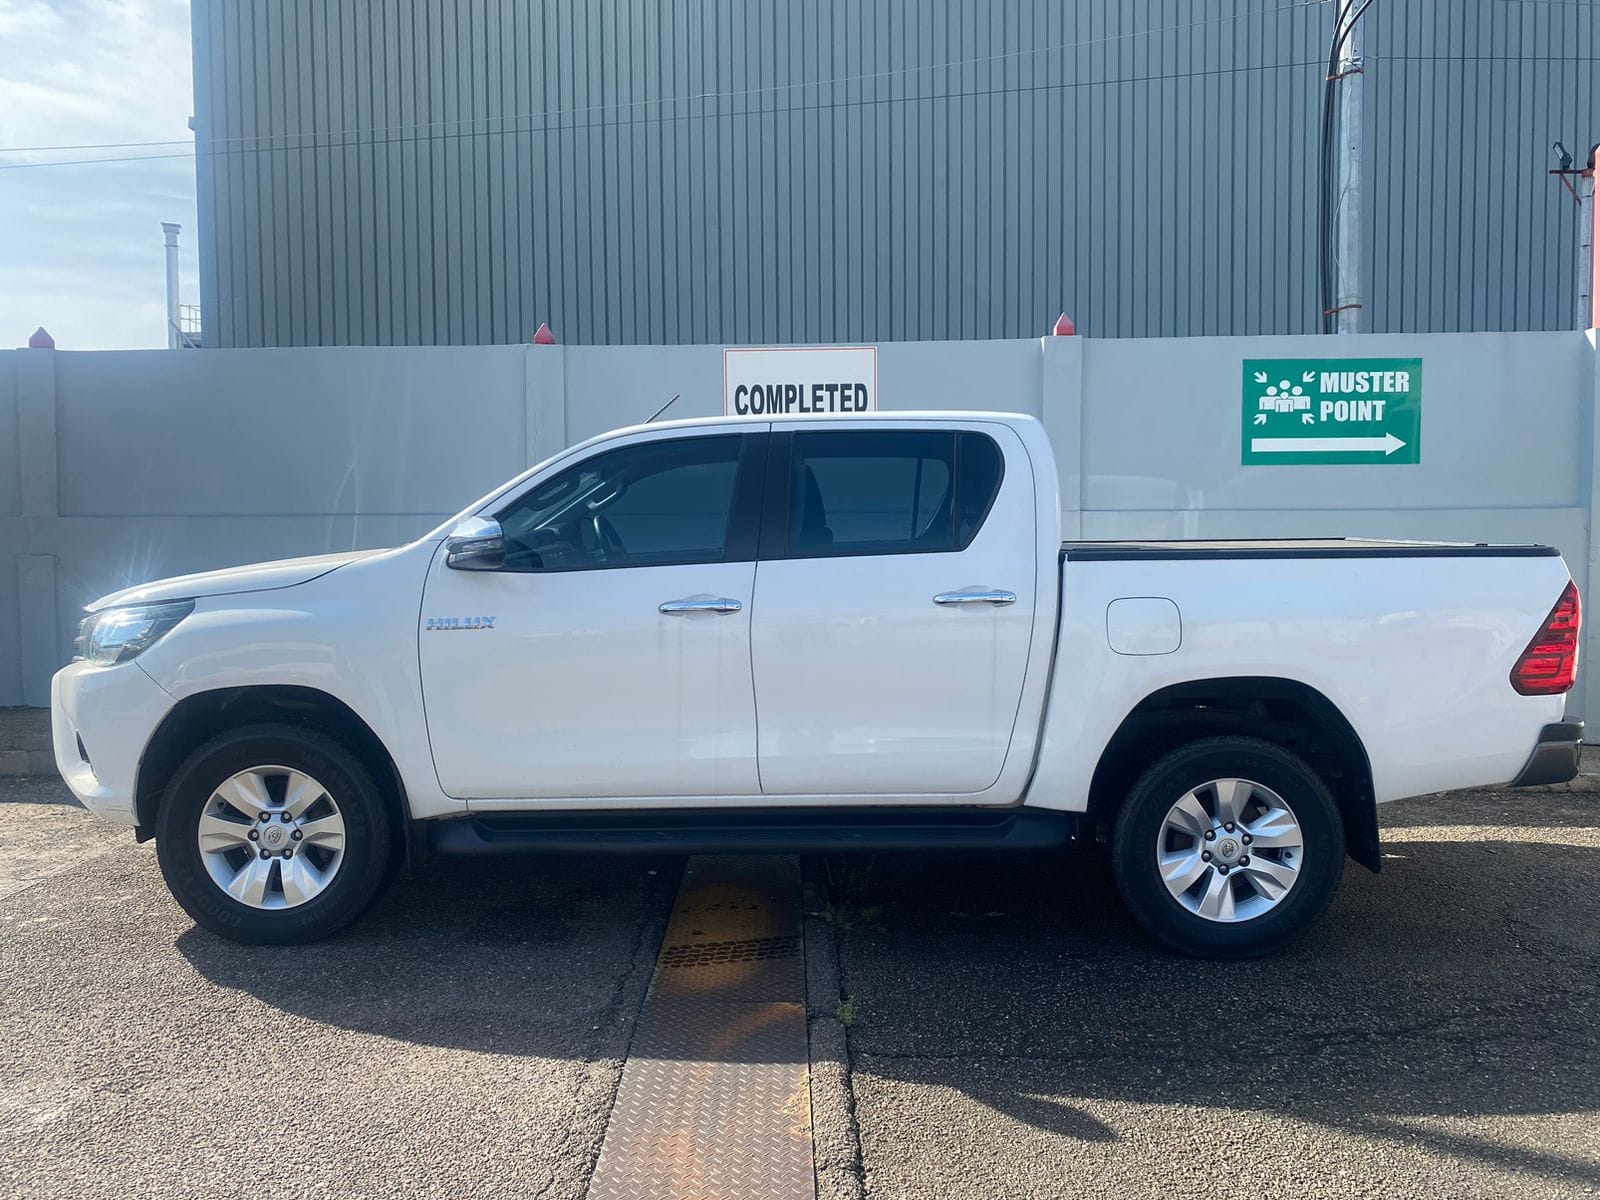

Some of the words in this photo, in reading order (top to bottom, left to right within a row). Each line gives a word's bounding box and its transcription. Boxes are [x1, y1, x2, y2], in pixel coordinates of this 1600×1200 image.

[1320, 371, 1410, 393] MUSTER
[734, 383, 869, 416] COMPLETED
[1320, 400, 1386, 422] POINT
[426, 616, 497, 630] HILUX
